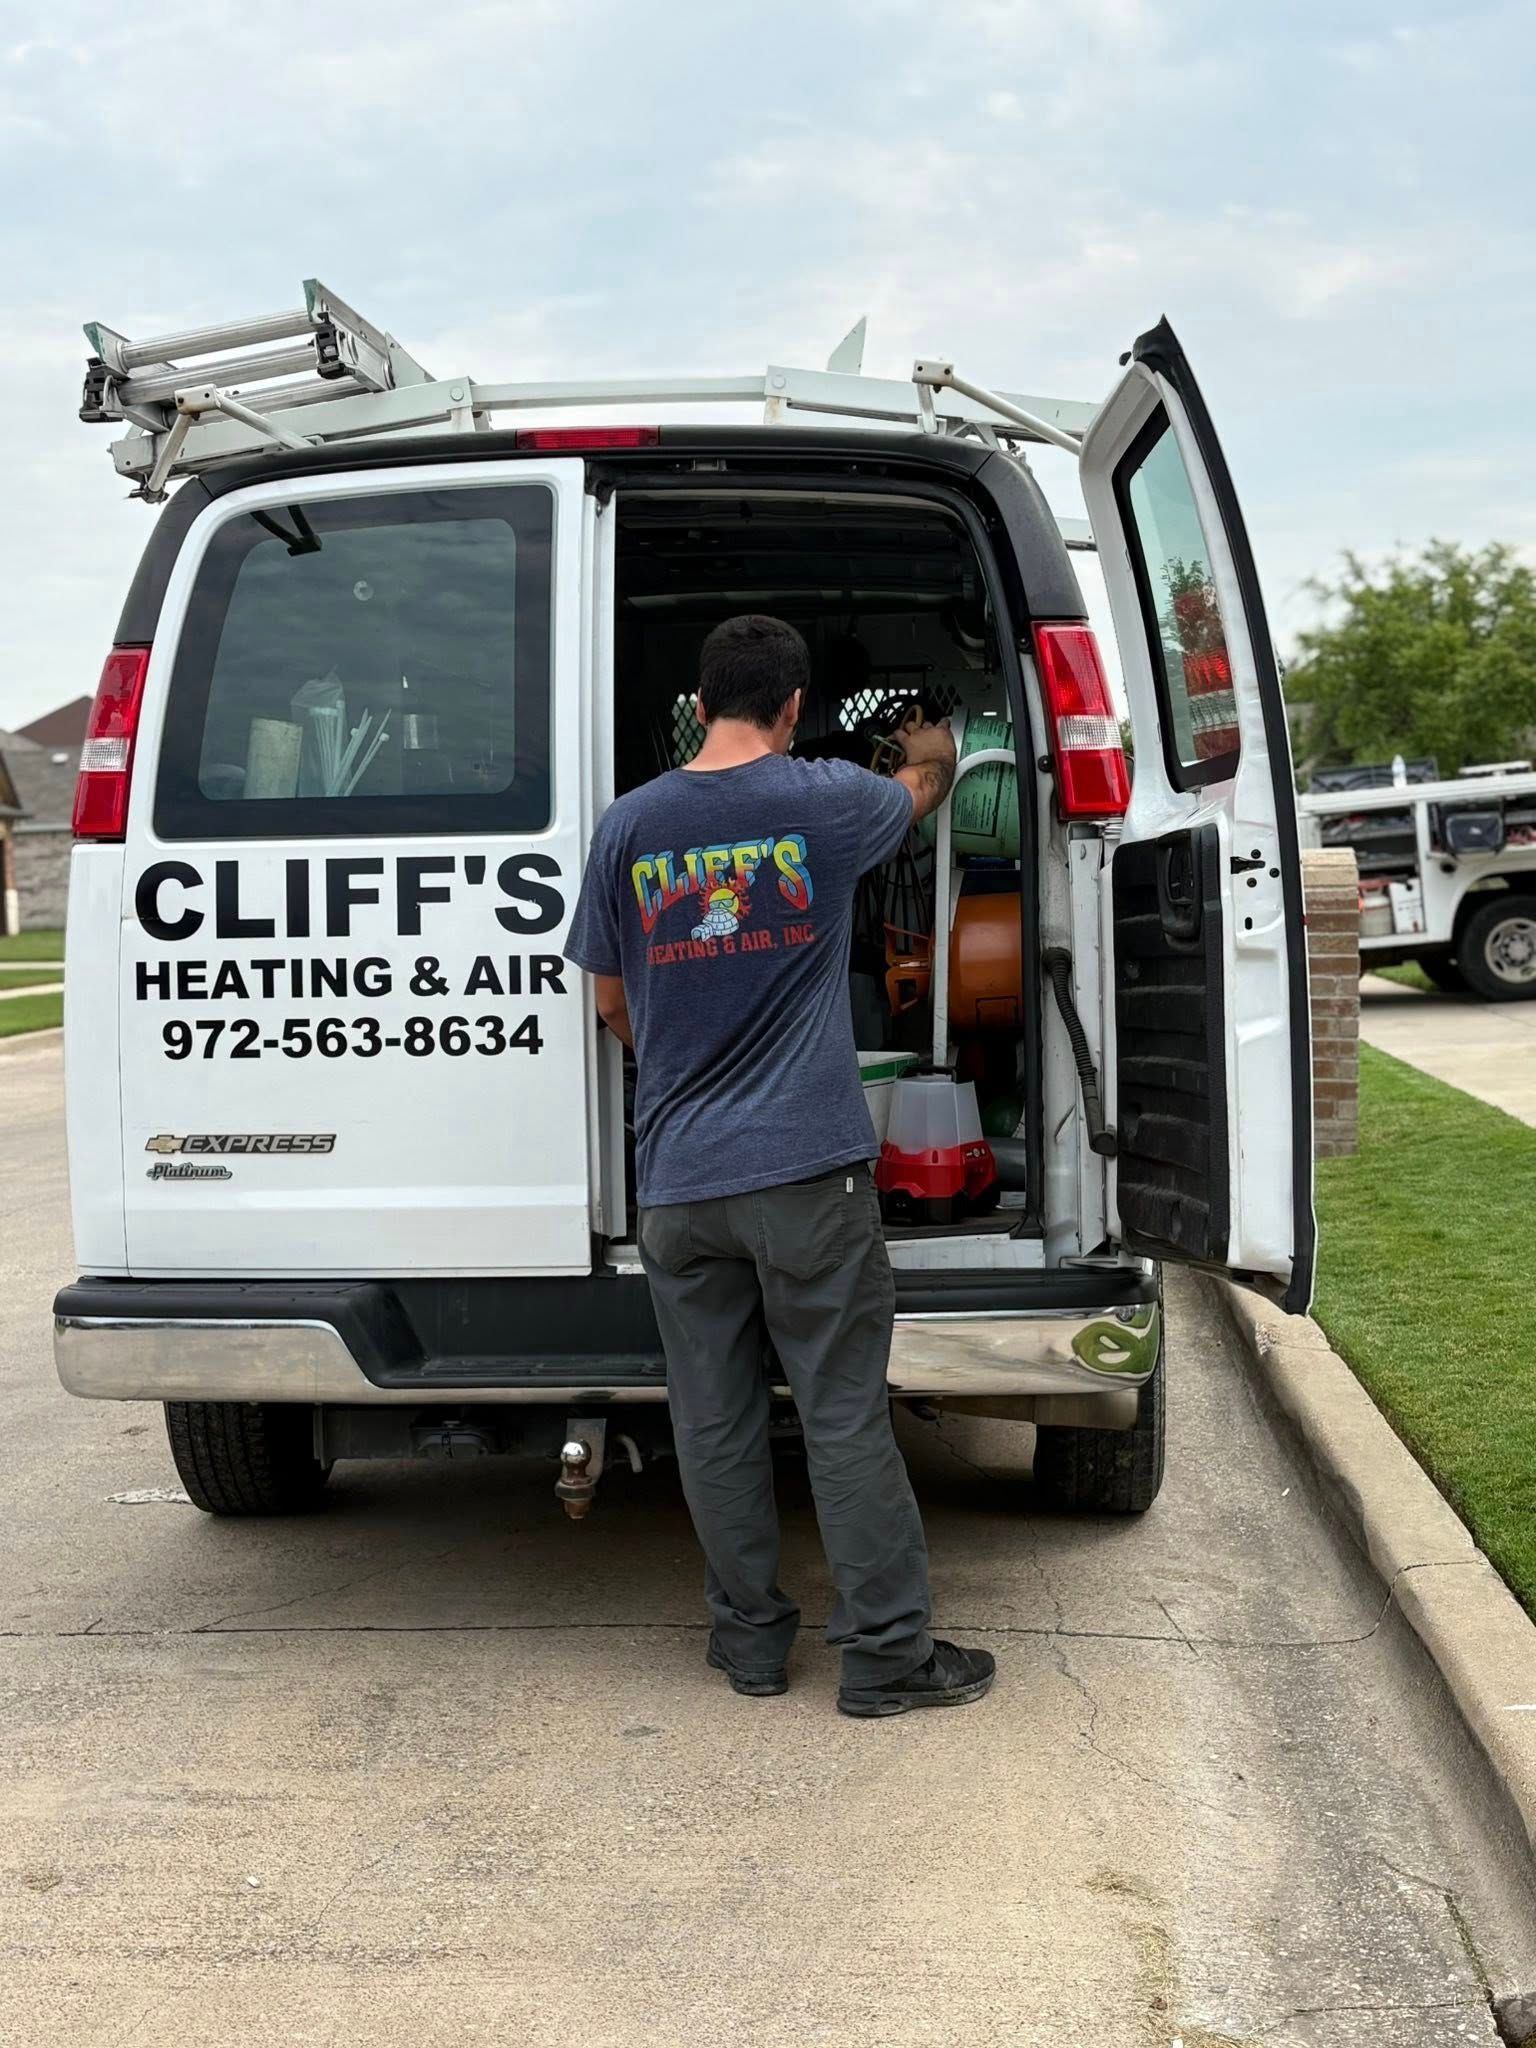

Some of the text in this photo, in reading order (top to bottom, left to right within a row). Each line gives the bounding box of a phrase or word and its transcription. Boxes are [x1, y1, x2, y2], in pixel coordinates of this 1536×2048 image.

[134, 853, 565, 941] CLIFF'S
[630, 833, 814, 935] CLIFF'S
[723, 935, 737, 954] &
[135, 954, 568, 1001] HEATING & AIR
[162, 1014, 544, 1061] 972-563-8634
[184, 1135, 334, 1153] EXPRESS
[147, 1162, 233, 1181] Platinum
